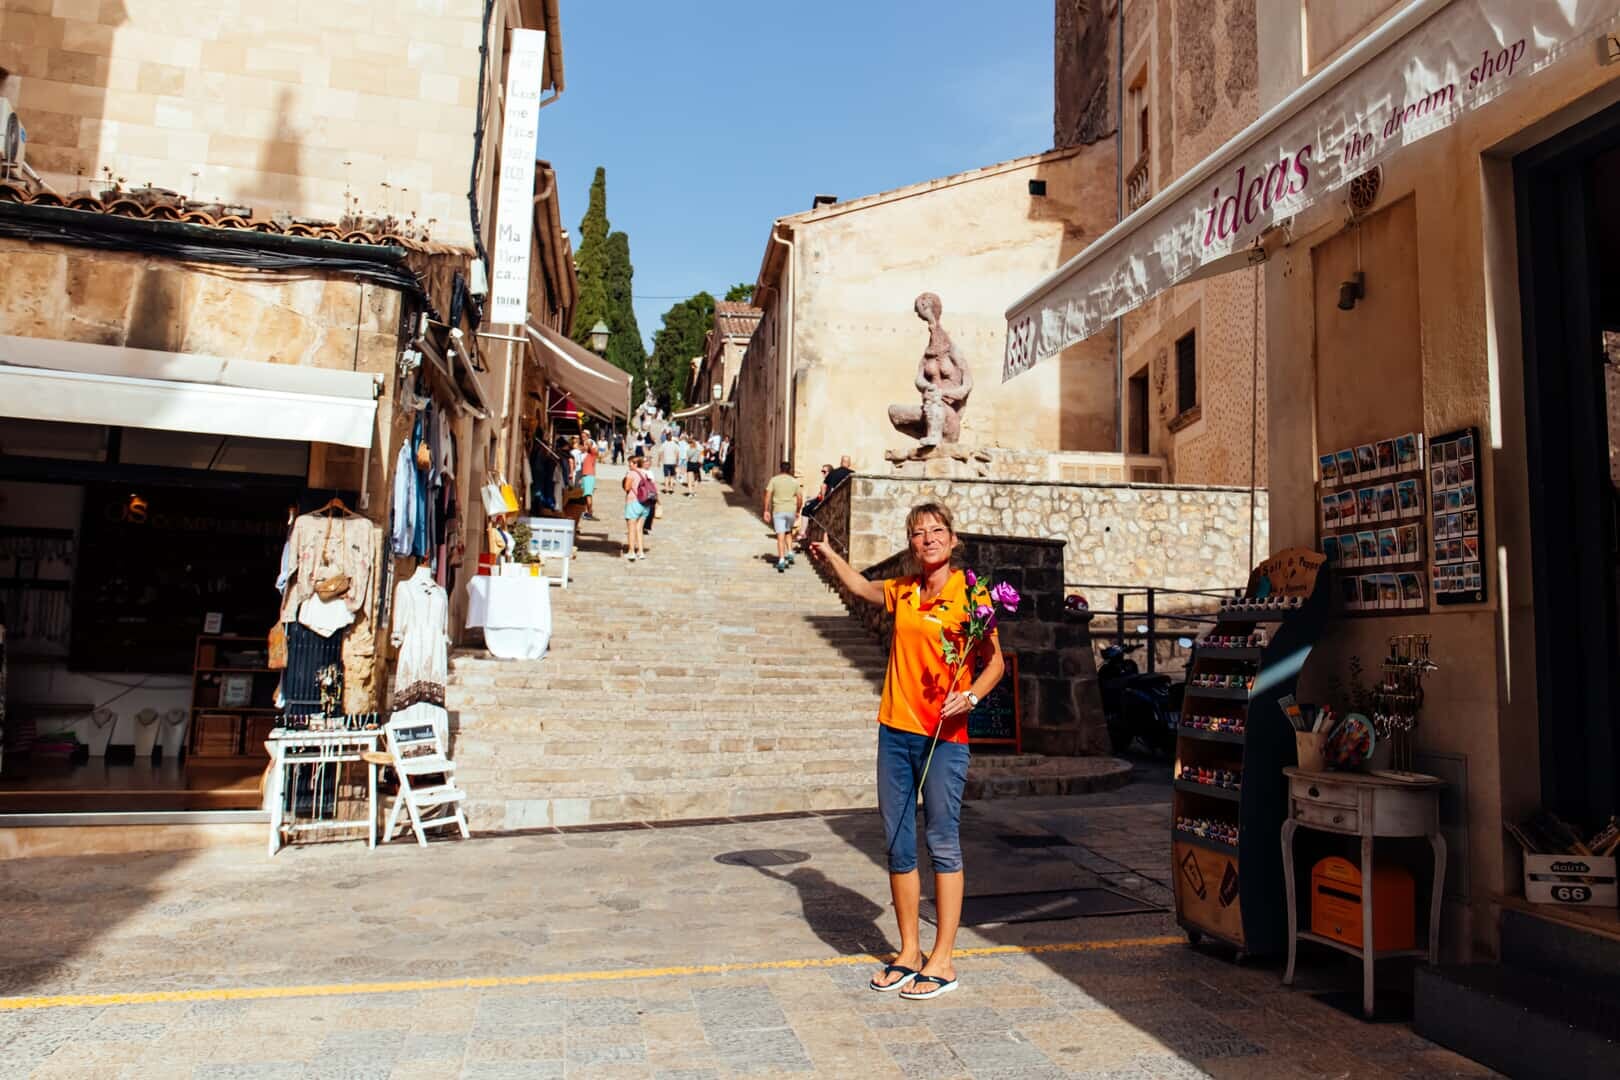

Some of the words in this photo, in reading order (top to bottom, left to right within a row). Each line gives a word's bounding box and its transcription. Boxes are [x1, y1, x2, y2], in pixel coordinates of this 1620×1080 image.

[1203, 144, 1312, 247] ideas
[1344, 132, 1373, 164] the
[1383, 83, 1455, 139] dream
[1468, 39, 1526, 90] shop
[1552, 863, 1587, 872] ROUTE
[1558, 887, 1585, 900] 66
